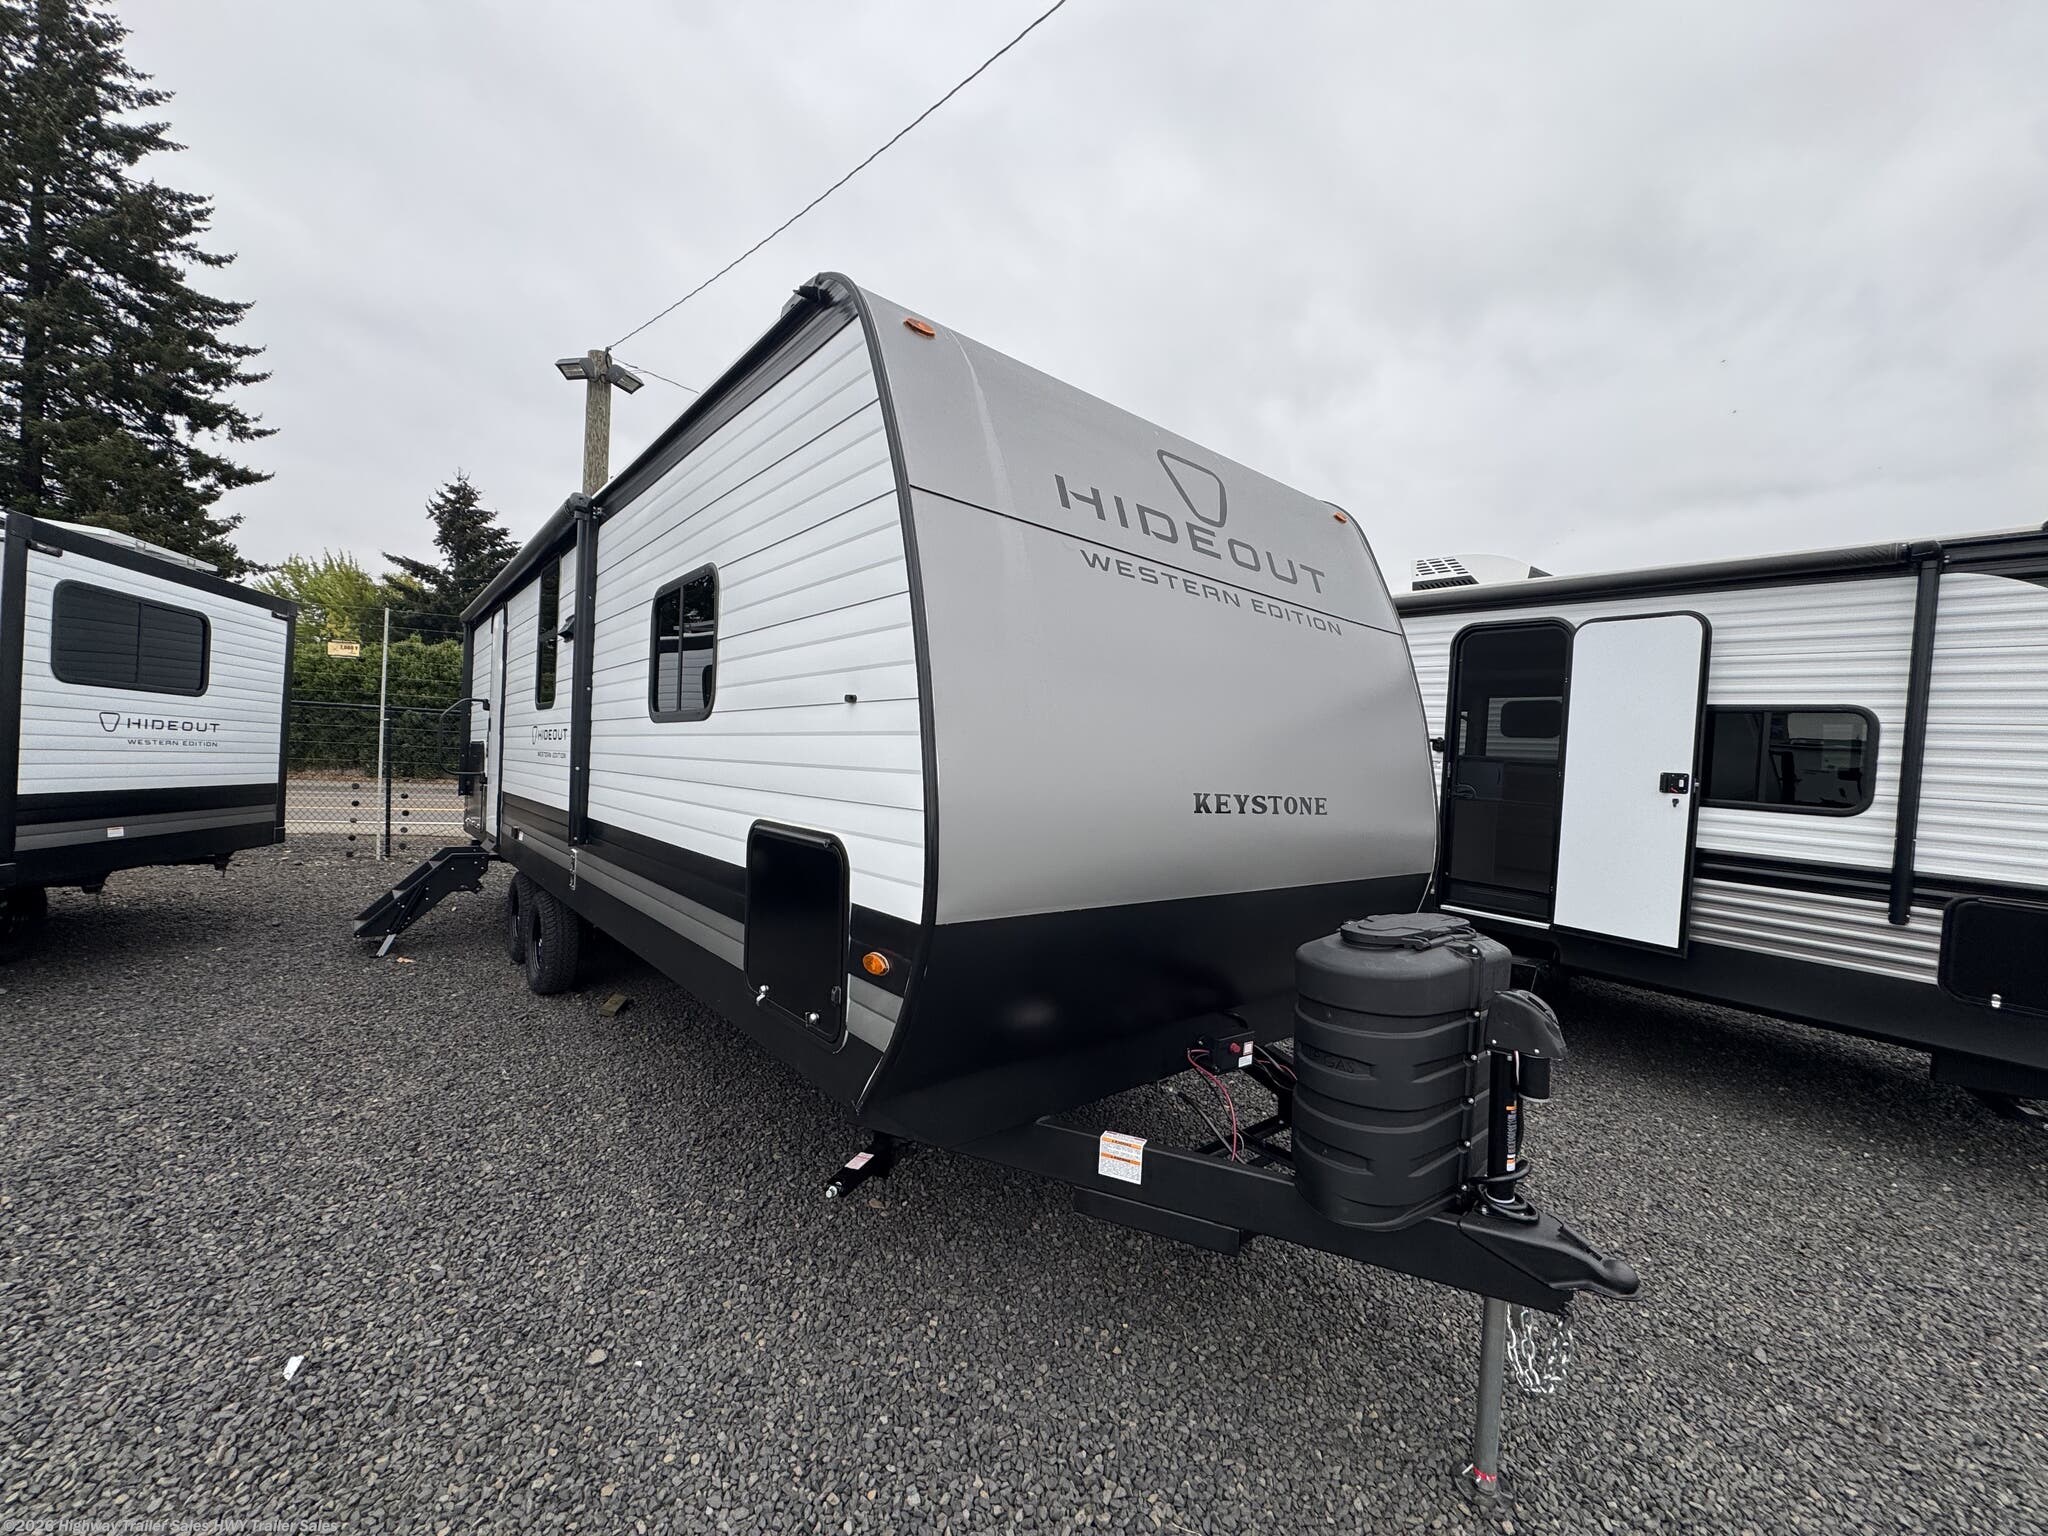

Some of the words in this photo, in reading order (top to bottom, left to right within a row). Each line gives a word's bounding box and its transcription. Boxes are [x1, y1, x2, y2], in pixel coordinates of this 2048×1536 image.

[1054, 473, 1325, 594] HIDEOUT
[1080, 549, 1241, 608] WESTERN
[1250, 598, 1342, 636] EDITION
[127, 717, 221, 733] HIDEOUT
[538, 729, 568, 740] HIDEOUT
[1193, 792, 1328, 816] KEYSTONE
